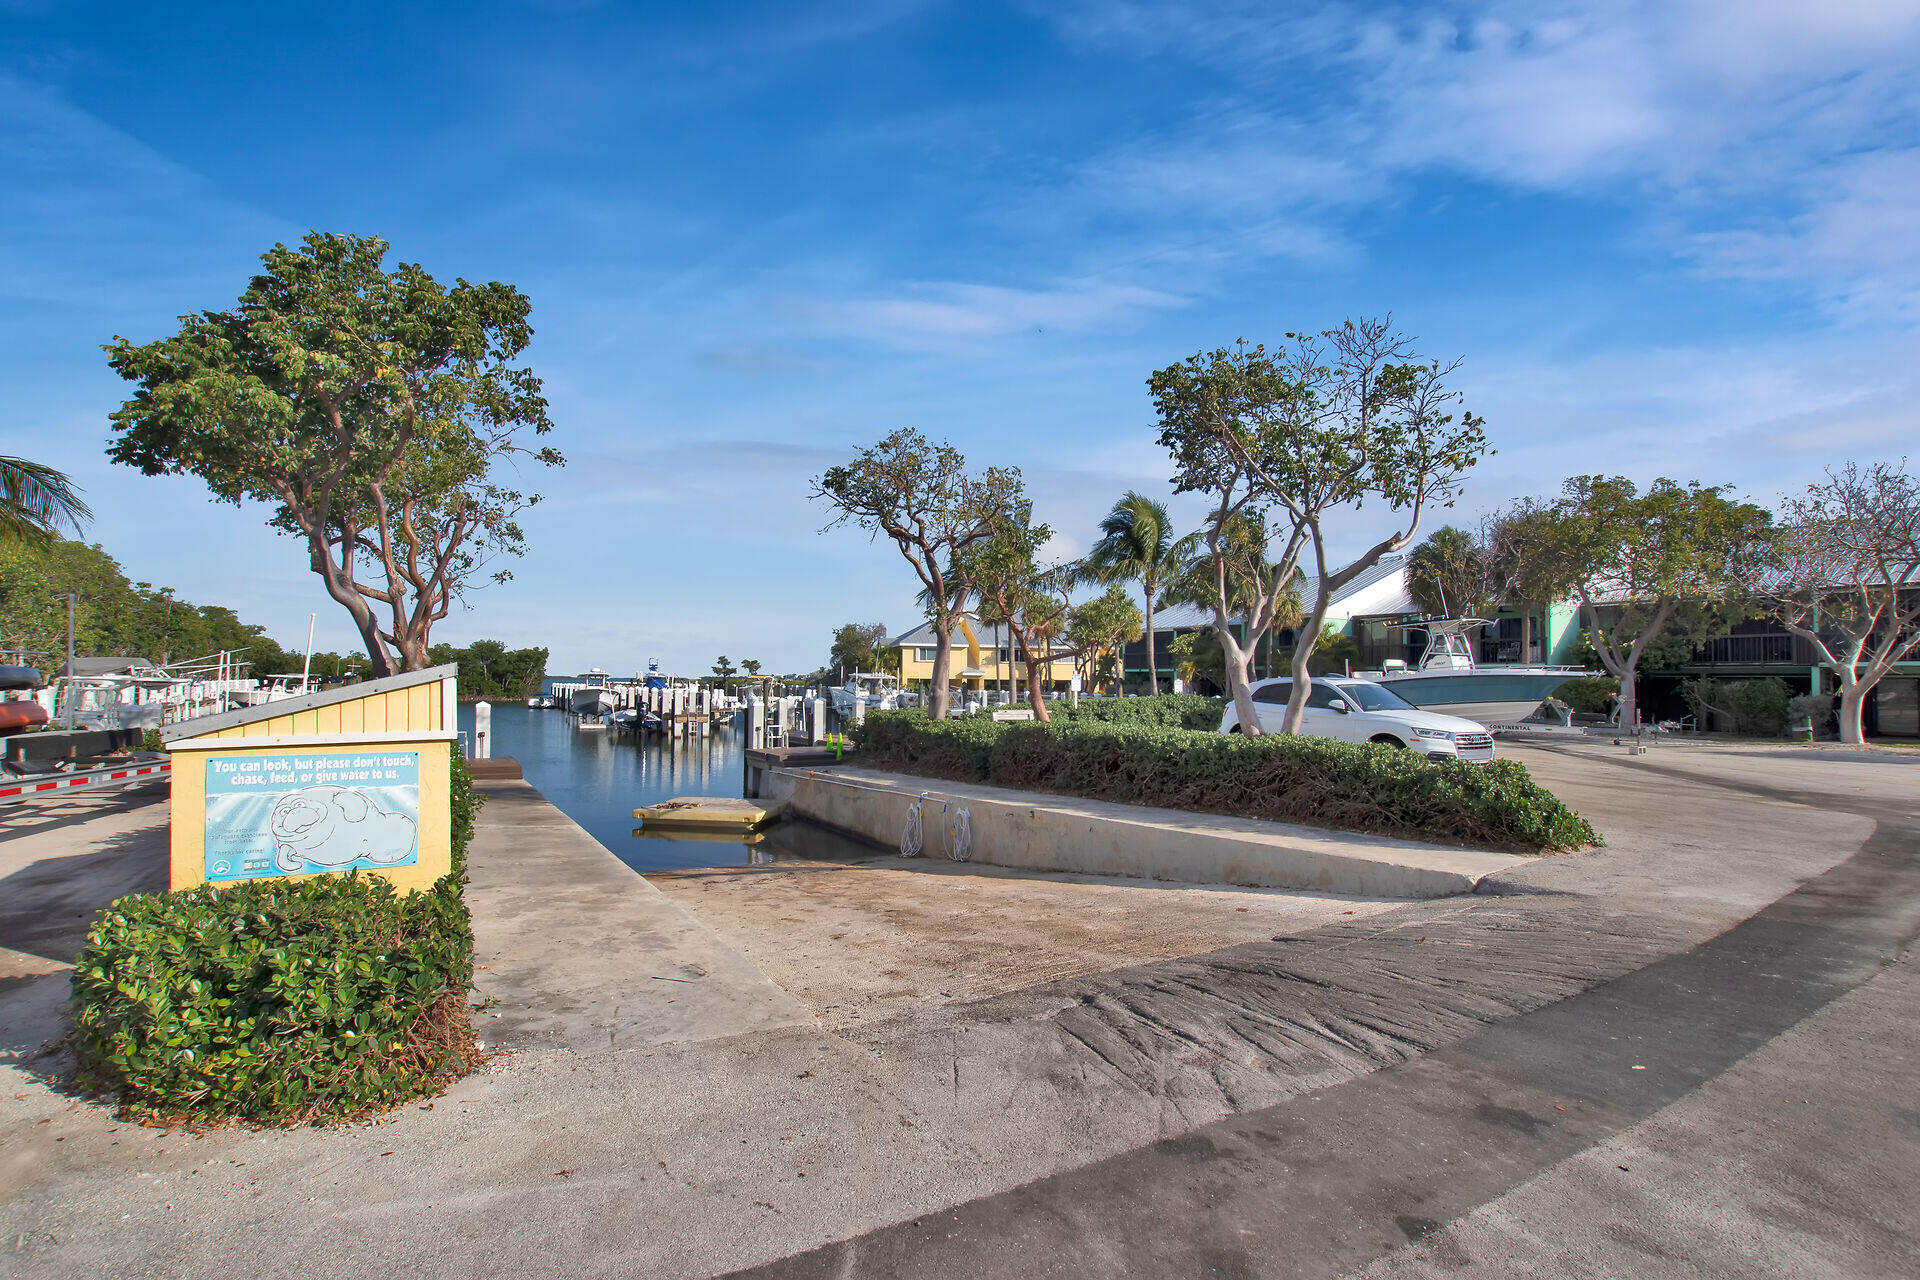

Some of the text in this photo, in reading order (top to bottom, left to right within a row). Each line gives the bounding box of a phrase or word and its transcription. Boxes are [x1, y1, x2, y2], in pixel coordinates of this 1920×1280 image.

[214, 754, 414, 772] You can look, but please don't touch,
[231, 769, 400, 785] chase, feed, or give water to us.
